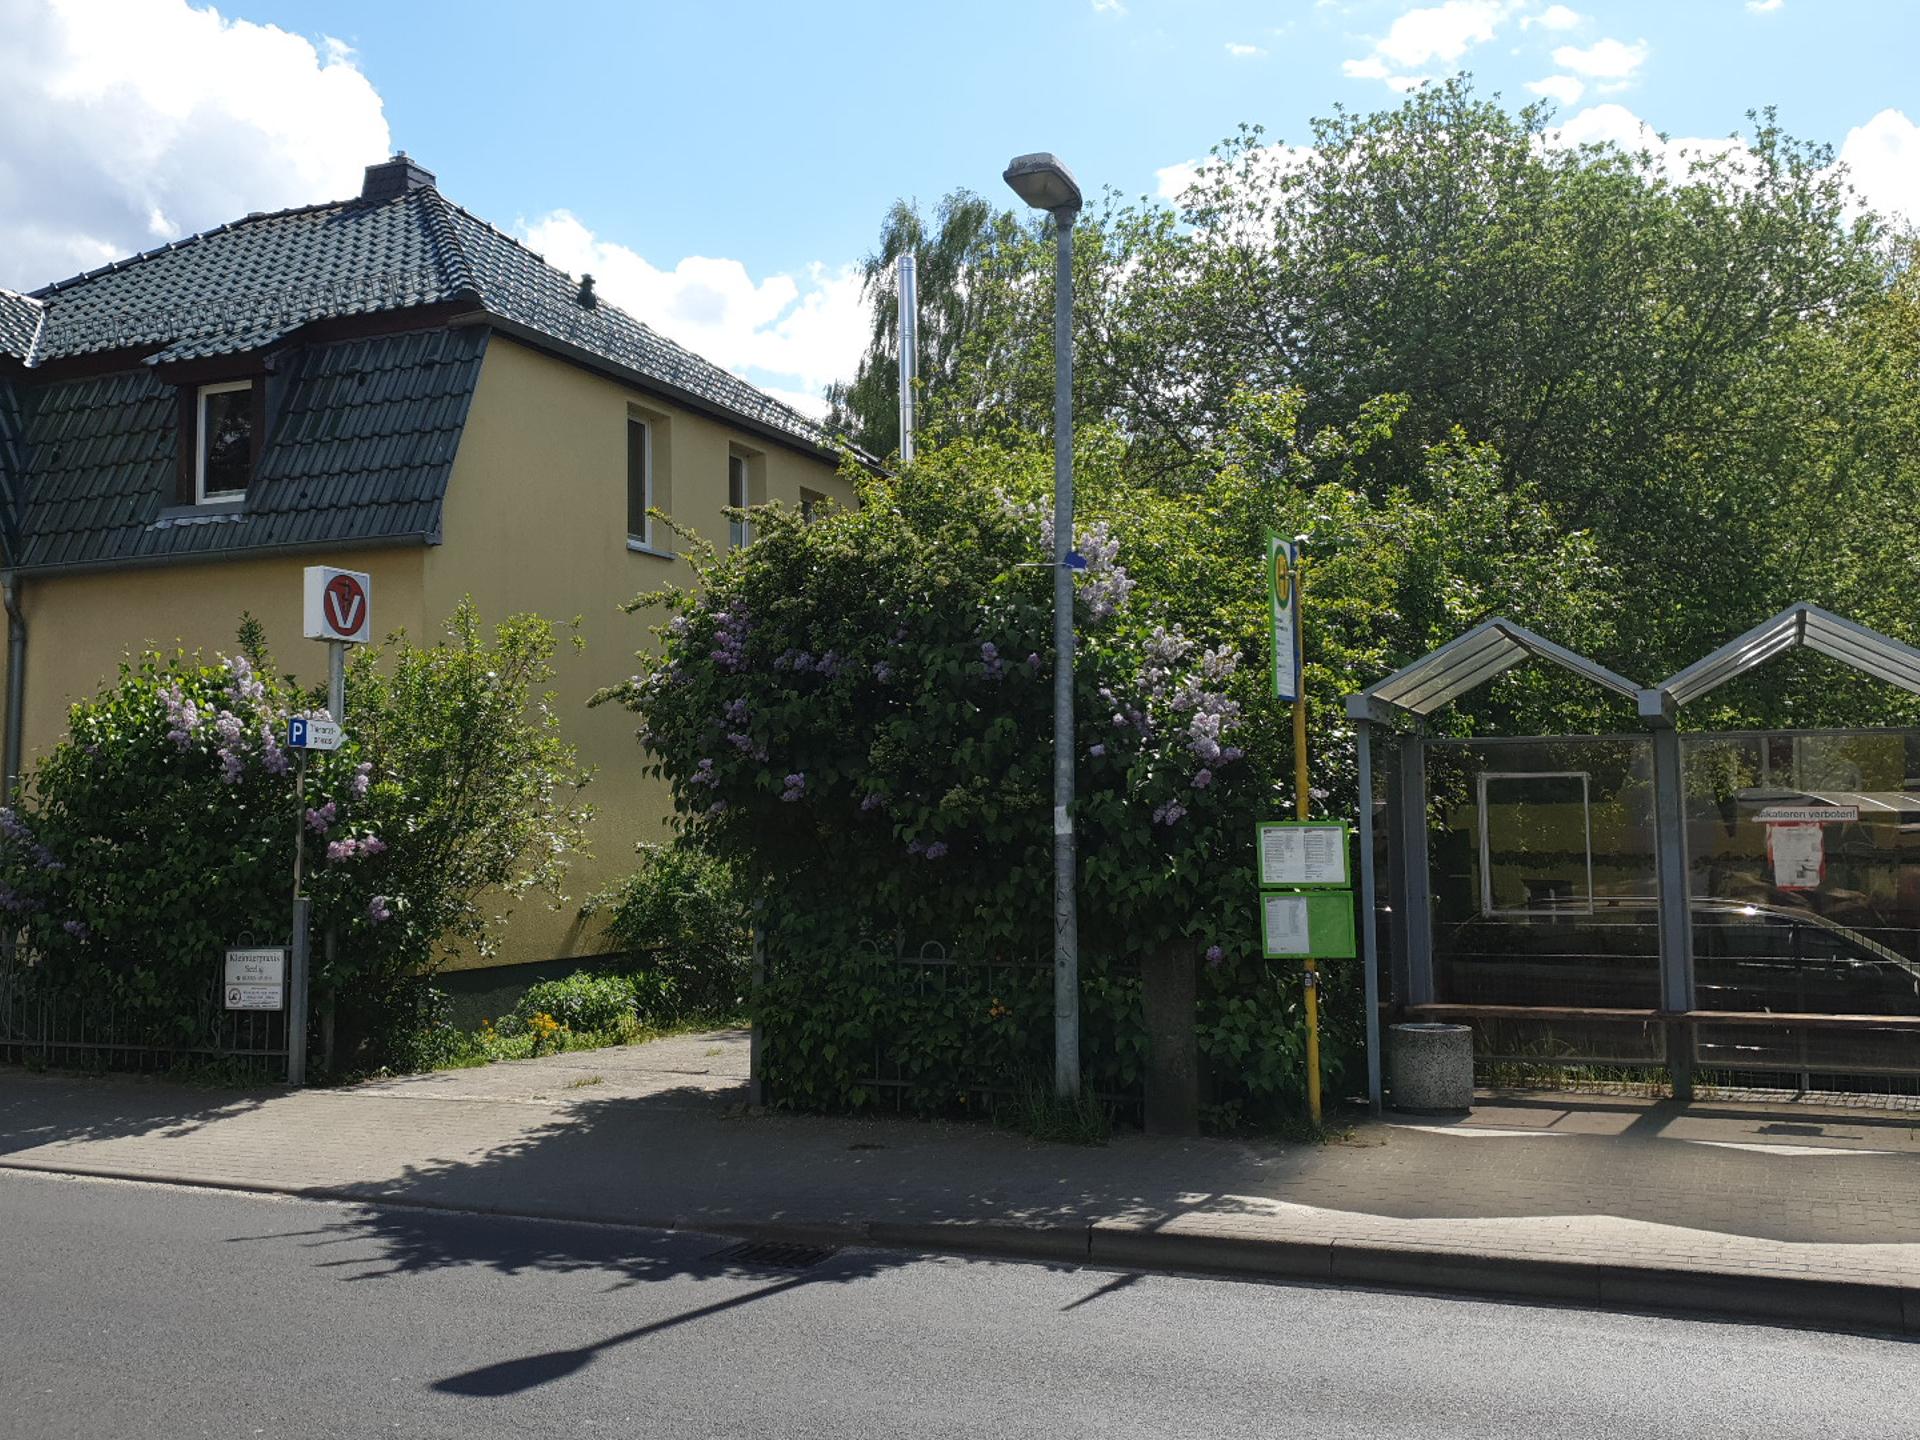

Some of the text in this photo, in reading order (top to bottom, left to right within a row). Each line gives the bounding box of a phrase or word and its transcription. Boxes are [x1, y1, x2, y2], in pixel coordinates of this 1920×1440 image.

[329, 591, 361, 629] V
[292, 722, 303, 742] P
[1808, 809, 1856, 818] verboten!
